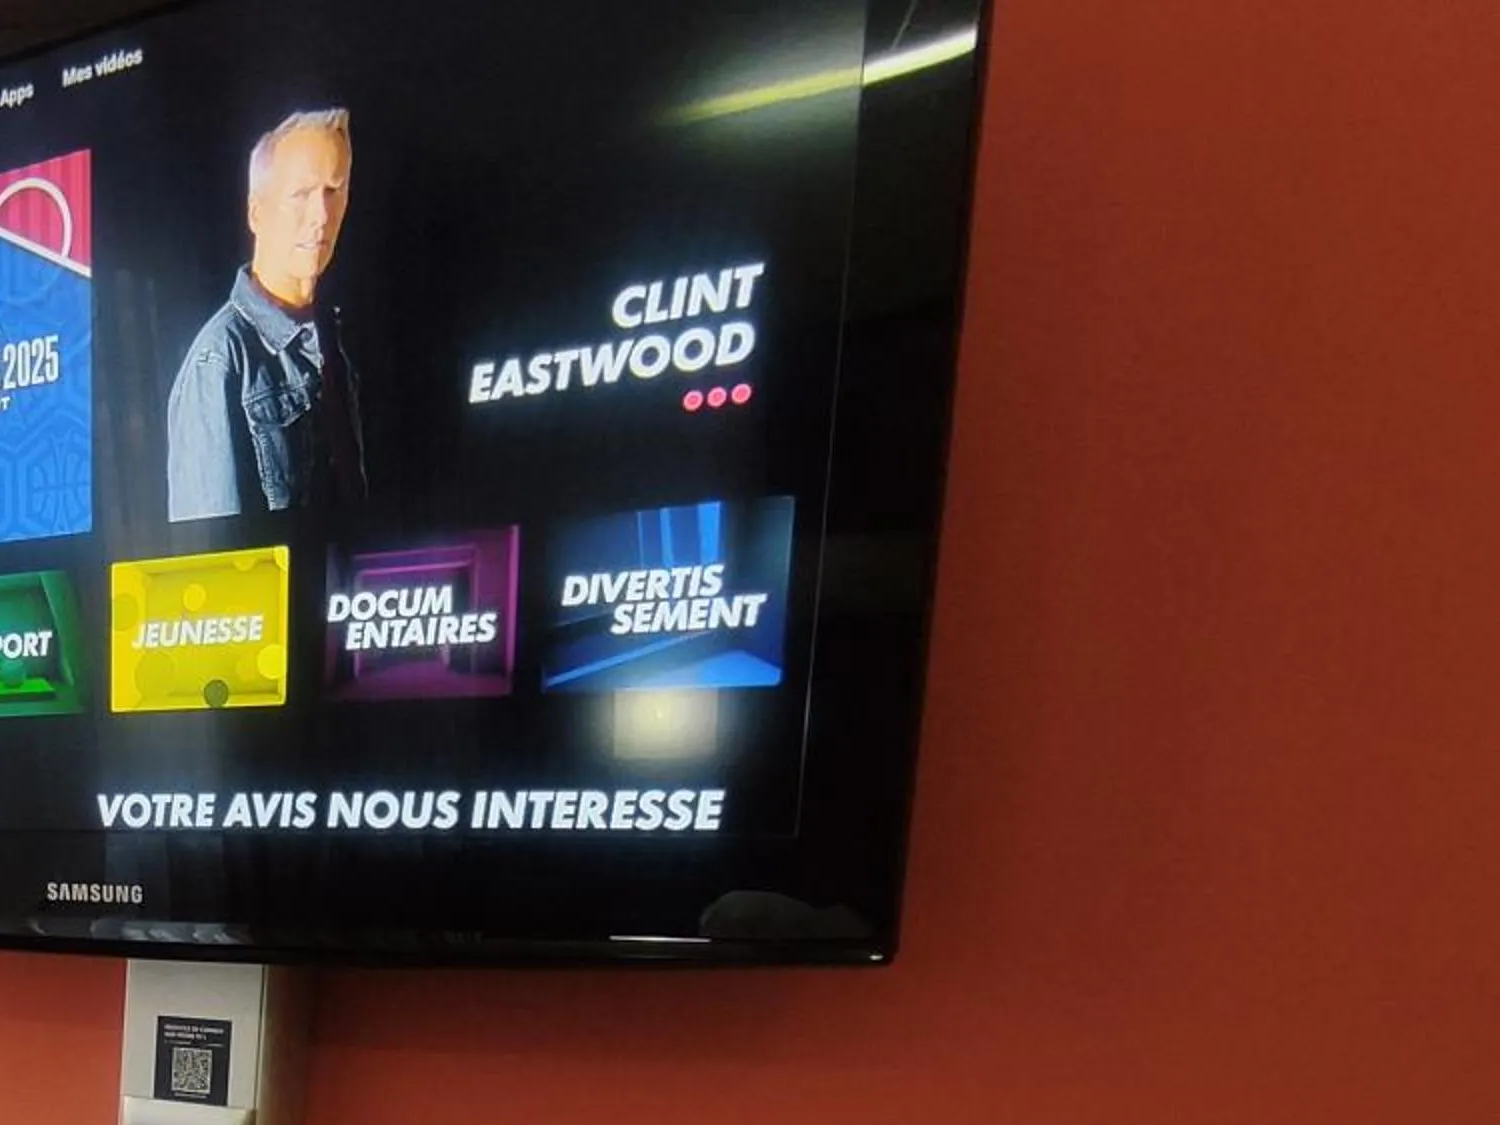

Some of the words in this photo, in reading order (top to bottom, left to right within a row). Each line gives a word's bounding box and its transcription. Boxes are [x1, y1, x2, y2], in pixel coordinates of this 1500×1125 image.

[61, 66, 93, 88] Mes
[94, 48, 143, 77] vidéos
[0, 81, 35, 108] Apps
[611, 262, 766, 329] CLINT
[2, 334, 60, 391] 2025
[468, 321, 757, 404] EASTWOOD
[327, 585, 453, 623] DOCUM
[561, 564, 725, 607] DIVERTIS
[132, 615, 264, 648] JEUNESSE
[345, 612, 498, 651] ENTAIRES
[610, 593, 768, 635] SEMENT
[97, 792, 217, 828] VOTRE
[221, 791, 317, 829] AVIS
[326, 790, 459, 830] NOUS
[470, 789, 725, 832] INTERESSE
[46, 882, 143, 904] SAMSUNG
